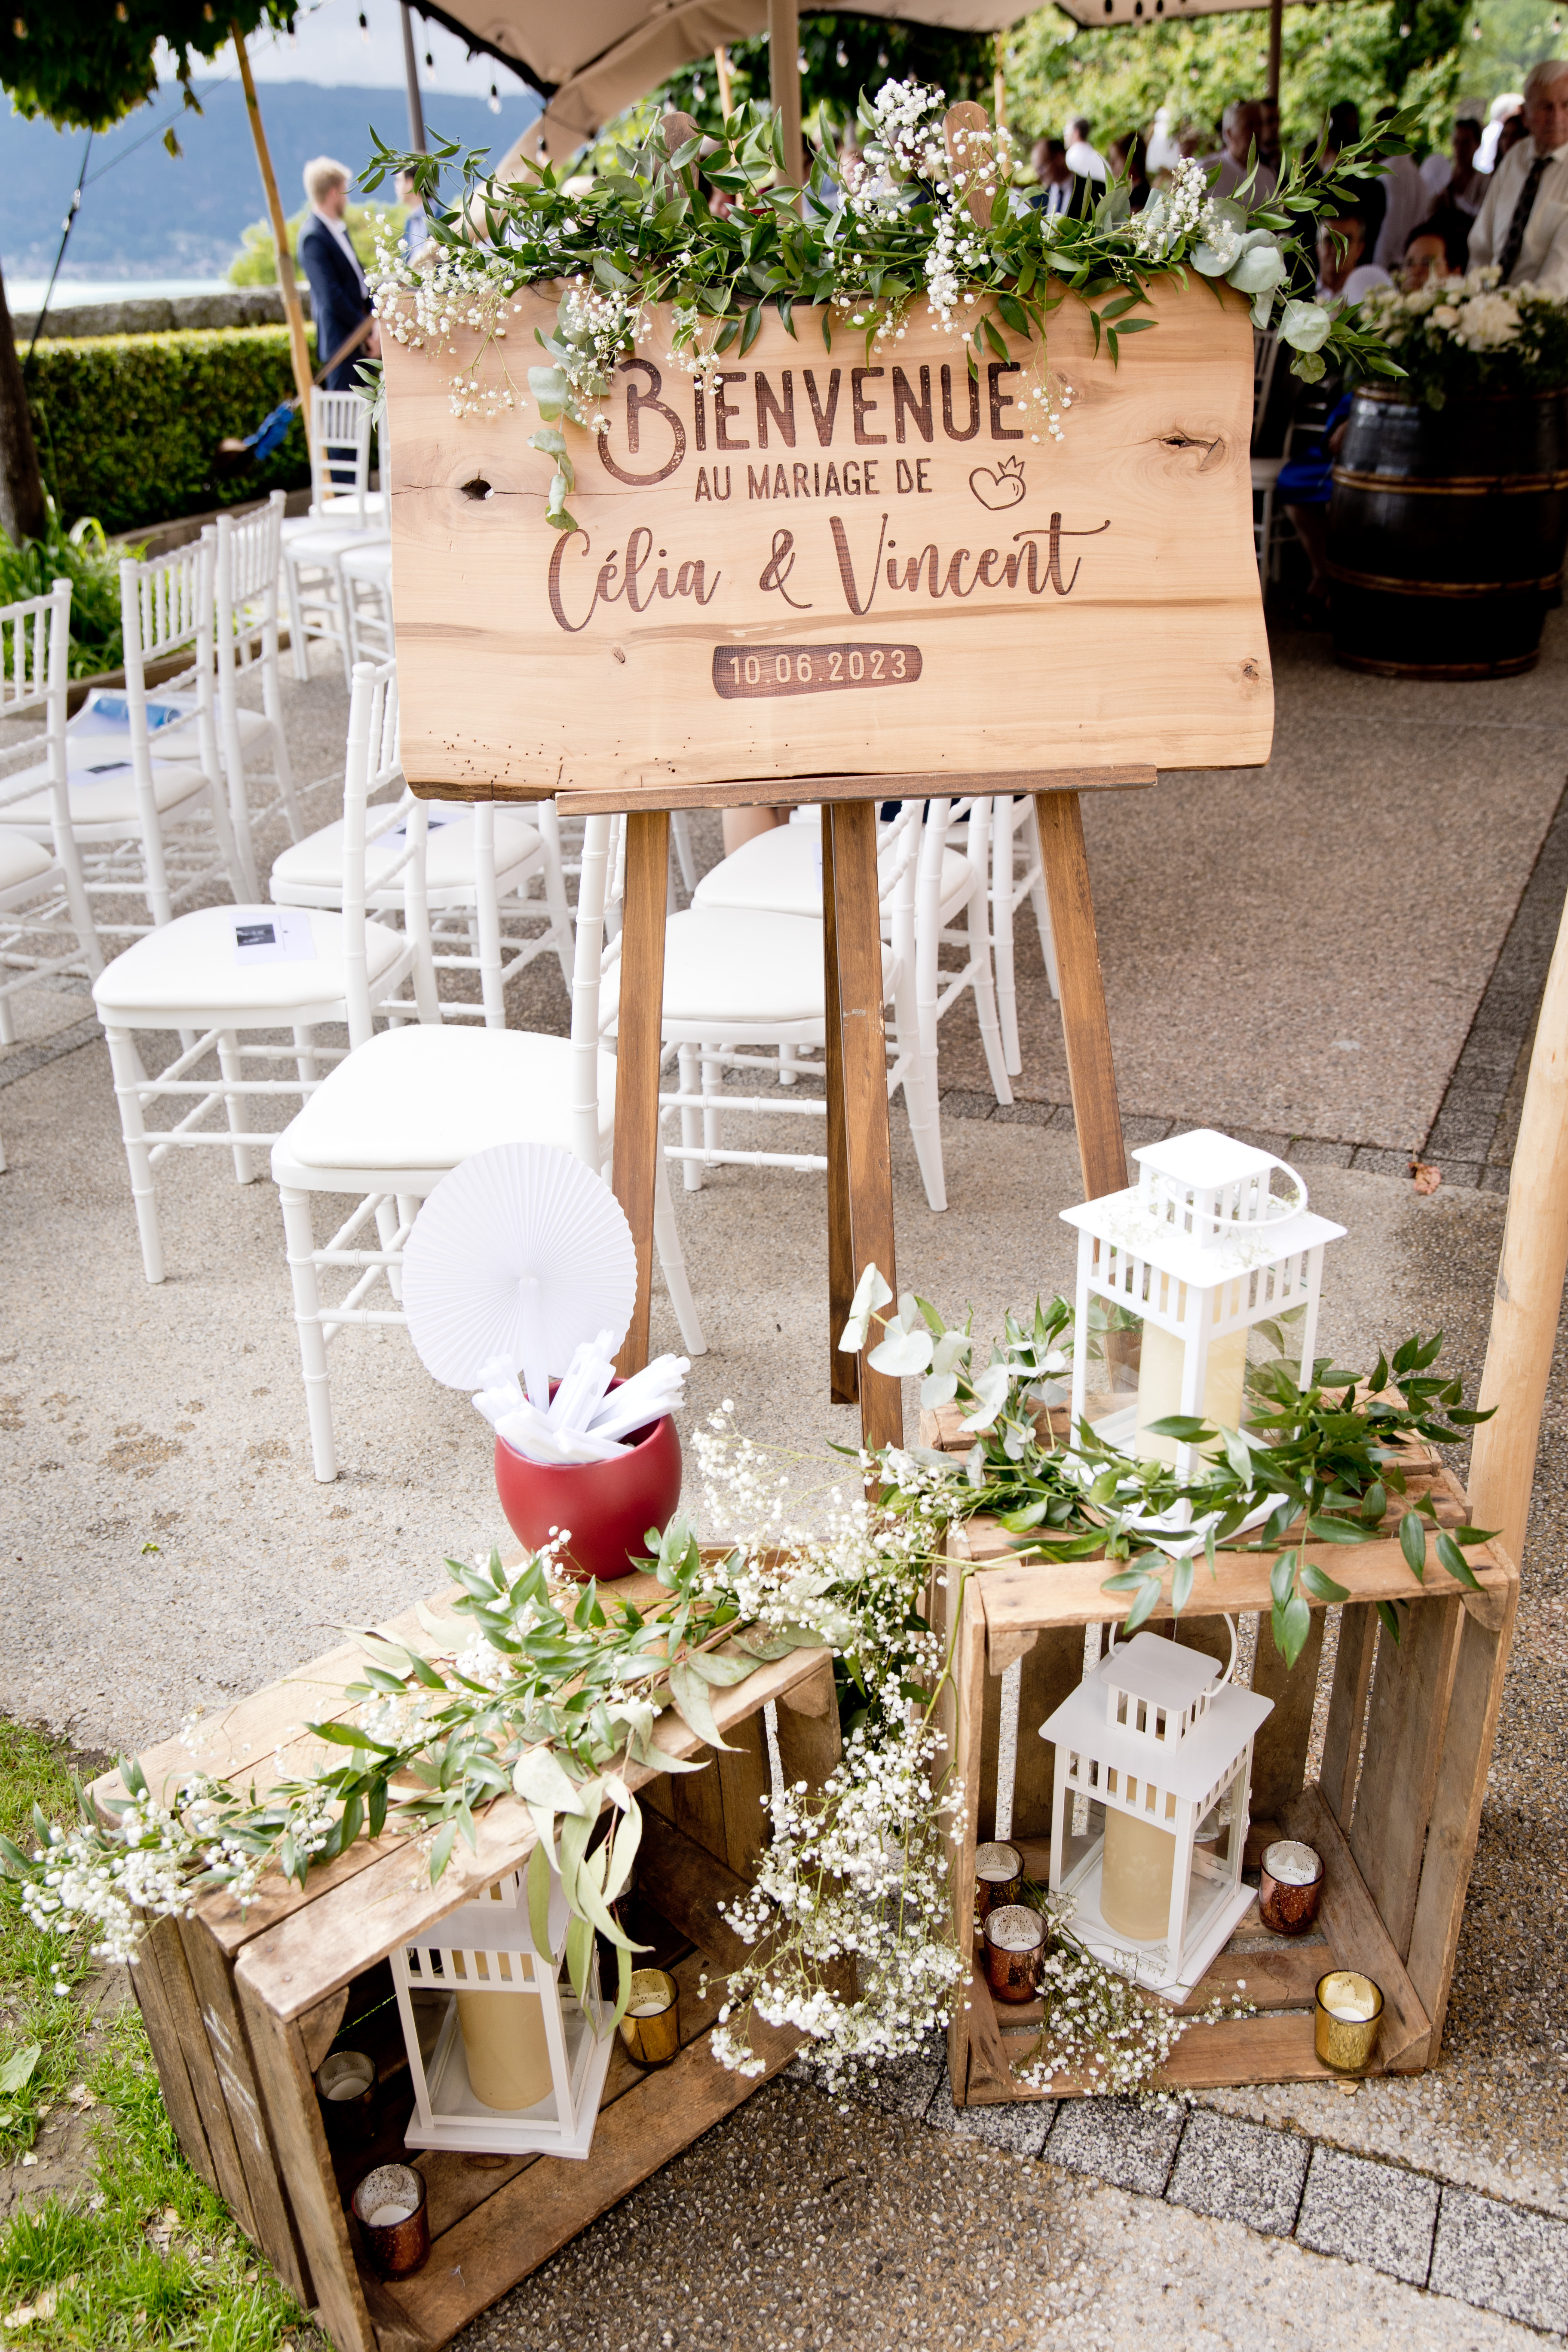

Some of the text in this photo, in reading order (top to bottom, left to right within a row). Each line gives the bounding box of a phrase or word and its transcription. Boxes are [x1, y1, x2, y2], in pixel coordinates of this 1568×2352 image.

[597, 358, 1024, 486] BIENVENUE
[695, 458, 933, 502] AU MARIAGE DE
[548, 512, 1111, 632] Célia & Vincent
[729, 649, 907, 686] 10.06.2023
